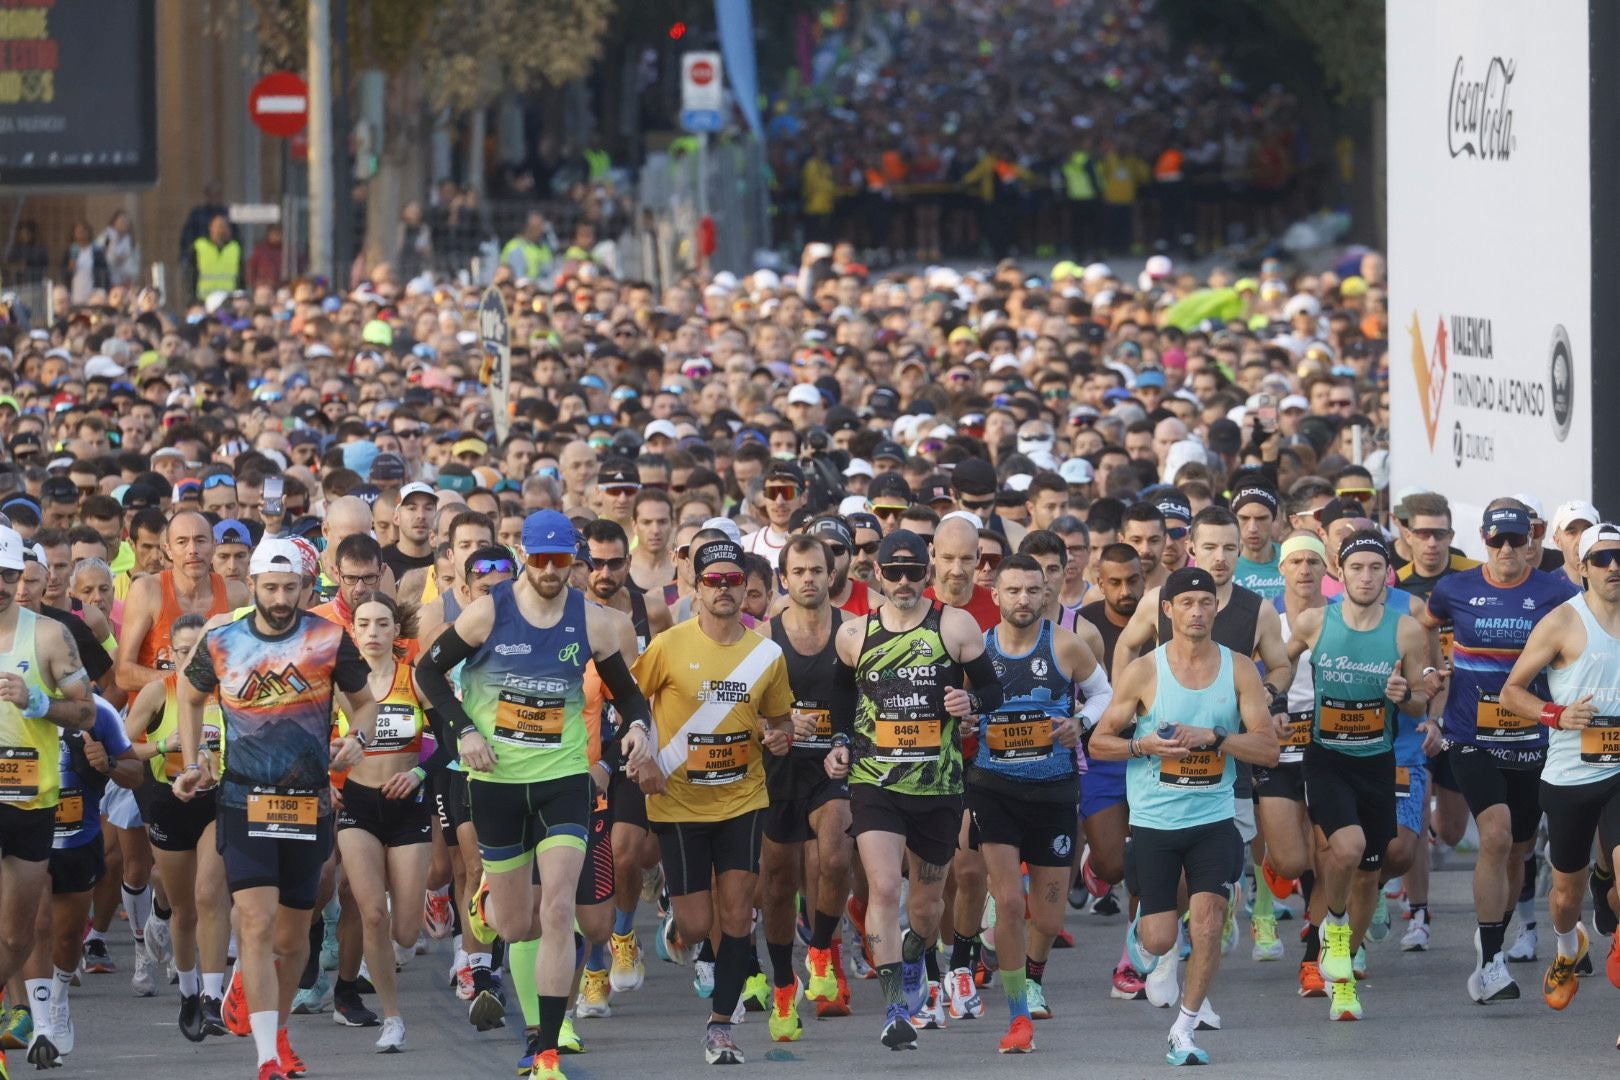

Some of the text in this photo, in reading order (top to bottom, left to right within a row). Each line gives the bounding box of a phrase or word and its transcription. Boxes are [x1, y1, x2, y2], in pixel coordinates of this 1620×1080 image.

[1451, 315, 1494, 359] VALENCIA
[1453, 371, 1545, 417] TRINIDAD ALFONSO
[1466, 433, 1494, 461] ZURICH
[1475, 616, 1533, 630] MARATÓN
[1318, 652, 1333, 668] La
[702, 680, 747, 693] #CORRO
[716, 691, 751, 704] MIEDO
[1498, 719, 1521, 728] Cesar
[894, 725, 920, 736] 8464
[1002, 726, 1033, 738] 10157
[898, 737, 918, 747] Xupi
[709, 746, 733, 759] 9704
[1518, 749, 1543, 763] MAX
[705, 758, 736, 769] ANDRES
[1180, 766, 1208, 776] Blanco
[268, 799, 298, 811] 11360
[266, 812, 298, 822] MINERO
